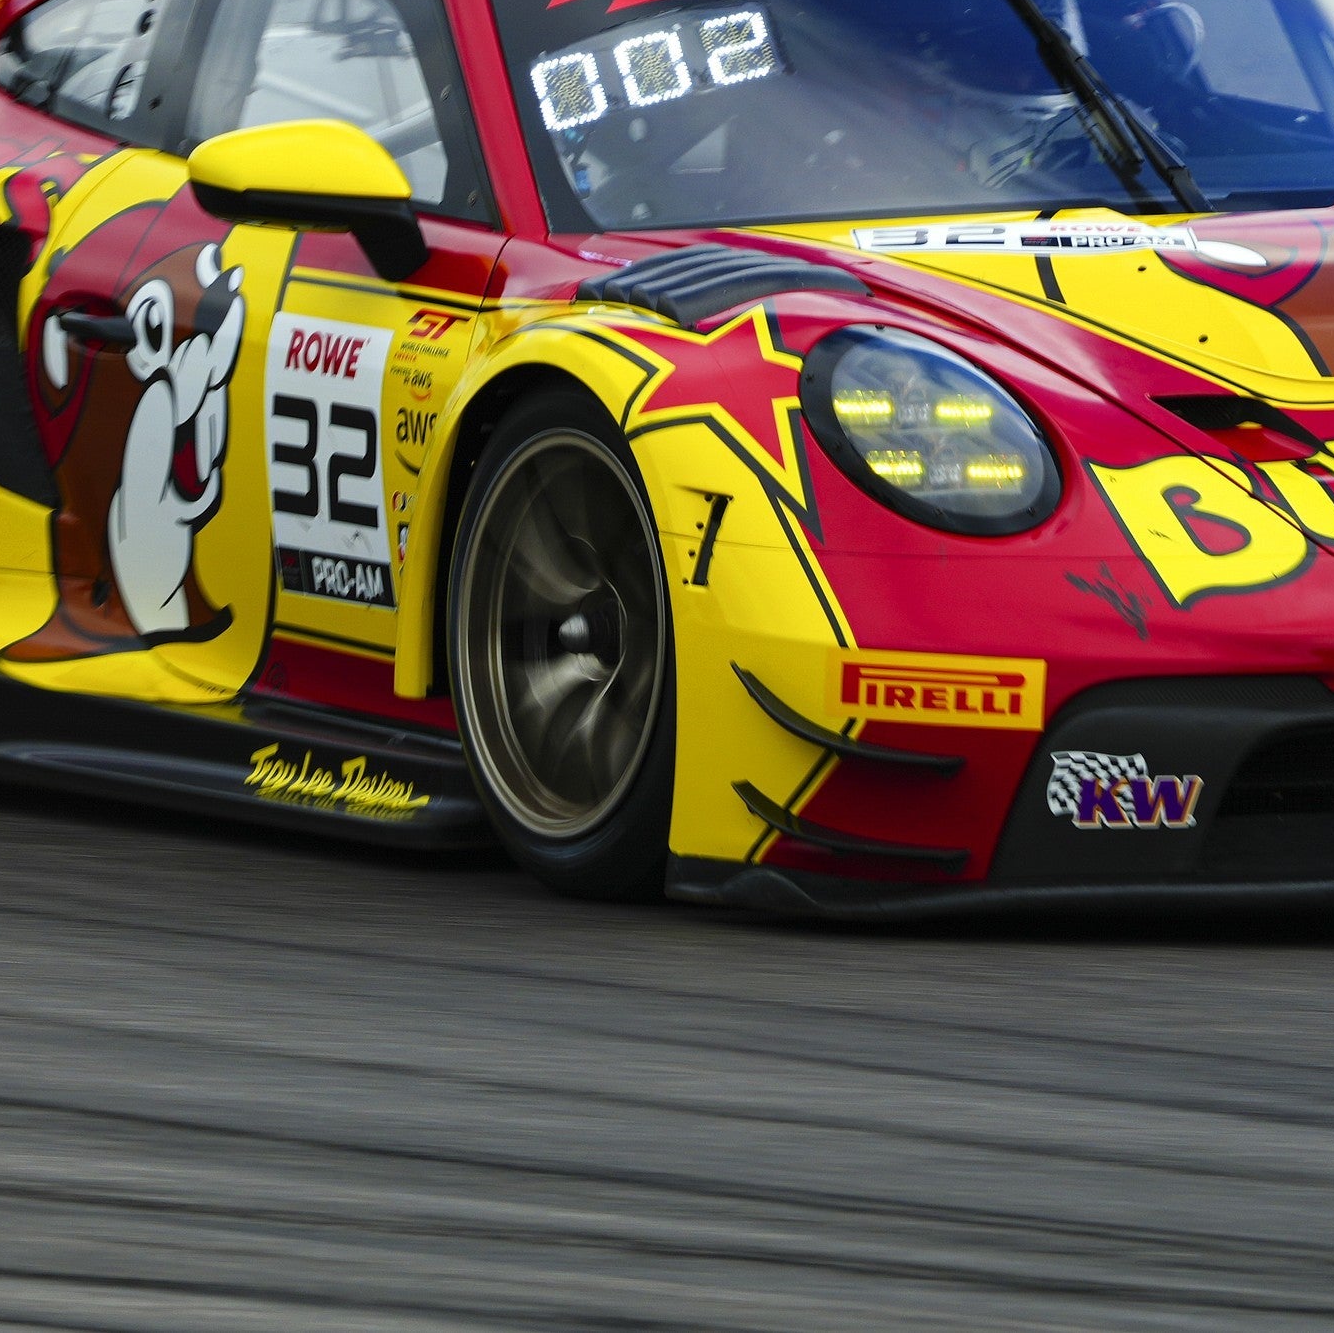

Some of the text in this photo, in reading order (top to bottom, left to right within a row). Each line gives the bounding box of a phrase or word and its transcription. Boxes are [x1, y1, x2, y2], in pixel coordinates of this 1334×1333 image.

[530, 11, 774, 131] 002
[871, 227, 1005, 246] 32
[1072, 236, 1175, 248] PRO-AM
[407, 308, 471, 340] GT
[284, 328, 365, 380] ROWE
[411, 369, 433, 389] aws
[272, 392, 378, 528] 32
[311, 556, 385, 601] PRO-AM
[841, 660, 1028, 716] PIRELLI
[1076, 774, 1204, 830] KW
